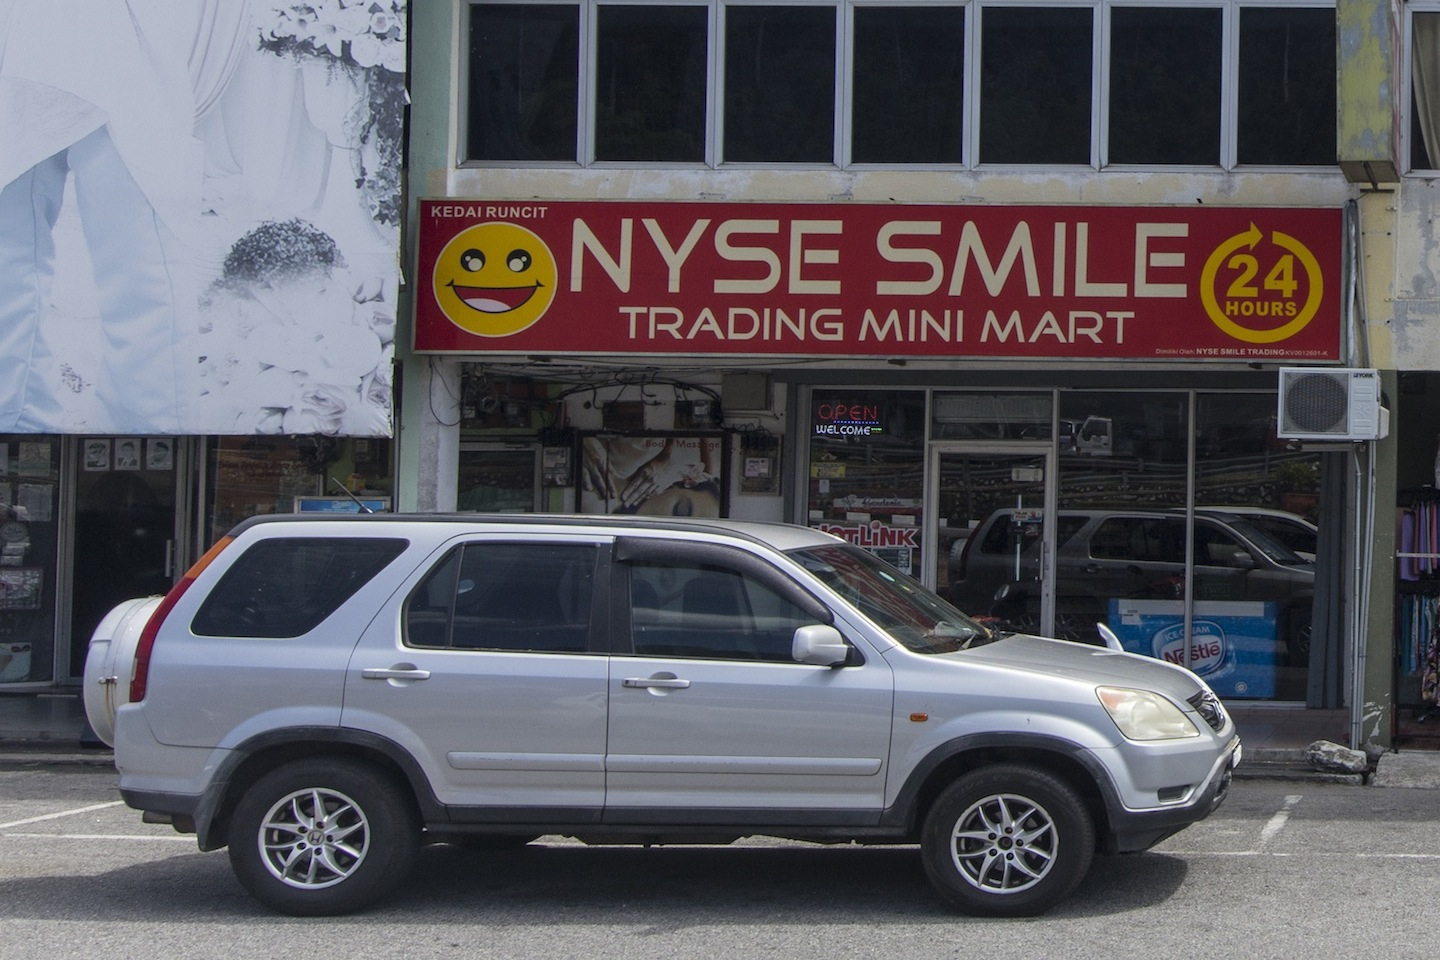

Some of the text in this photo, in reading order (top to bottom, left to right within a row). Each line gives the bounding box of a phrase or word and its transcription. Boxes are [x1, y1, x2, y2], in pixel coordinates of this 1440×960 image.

[431, 206, 548, 218] KEDAI RUNCIT
[570, 218, 1188, 298] NYSE SMILE
[1226, 254, 1298, 299] 24
[1226, 301, 1297, 317] HOURS
[618, 306, 1134, 344] TRADING MINI MART
[818, 404, 878, 420] OPEN
[816, 424, 871, 435] WELCOME
[1165, 630, 1179, 641] ICE
